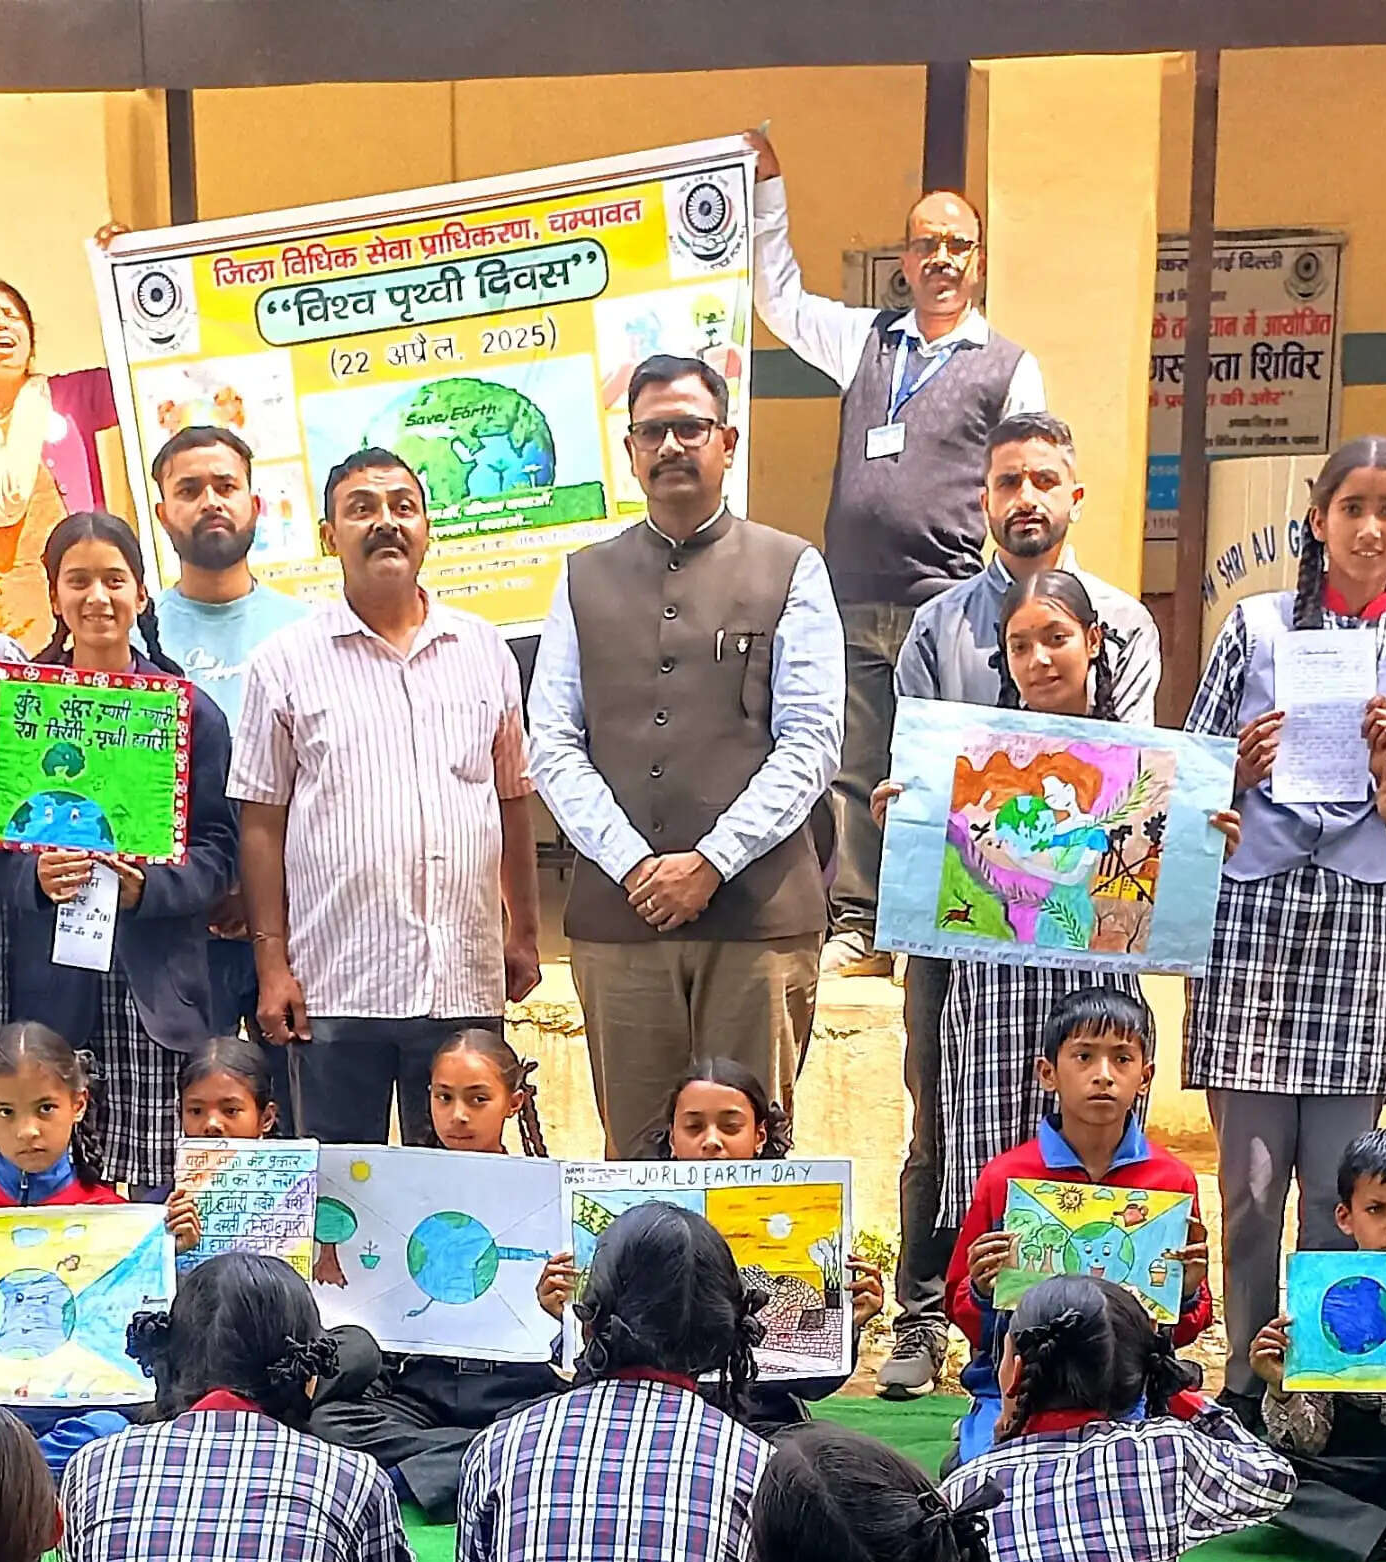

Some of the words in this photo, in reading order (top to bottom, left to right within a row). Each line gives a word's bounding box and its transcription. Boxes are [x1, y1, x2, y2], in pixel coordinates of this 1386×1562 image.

[214, 257, 274, 286] जिला
[282, 245, 357, 278] विधिक
[365, 236, 412, 266] सेवा
[549, 200, 641, 234] चम्पावत
[385, 263, 465, 322] पृथ्वी
[330, 348, 371, 380] (22
[482, 316, 557, 354] 2025)
[1251, 341, 1324, 381] शिविर
[1217, 543, 1247, 588] SHRI
[628, 1166, 697, 1187] WORLD
[704, 1167, 762, 1184] EARTH
[771, 1164, 813, 1183] DAY
